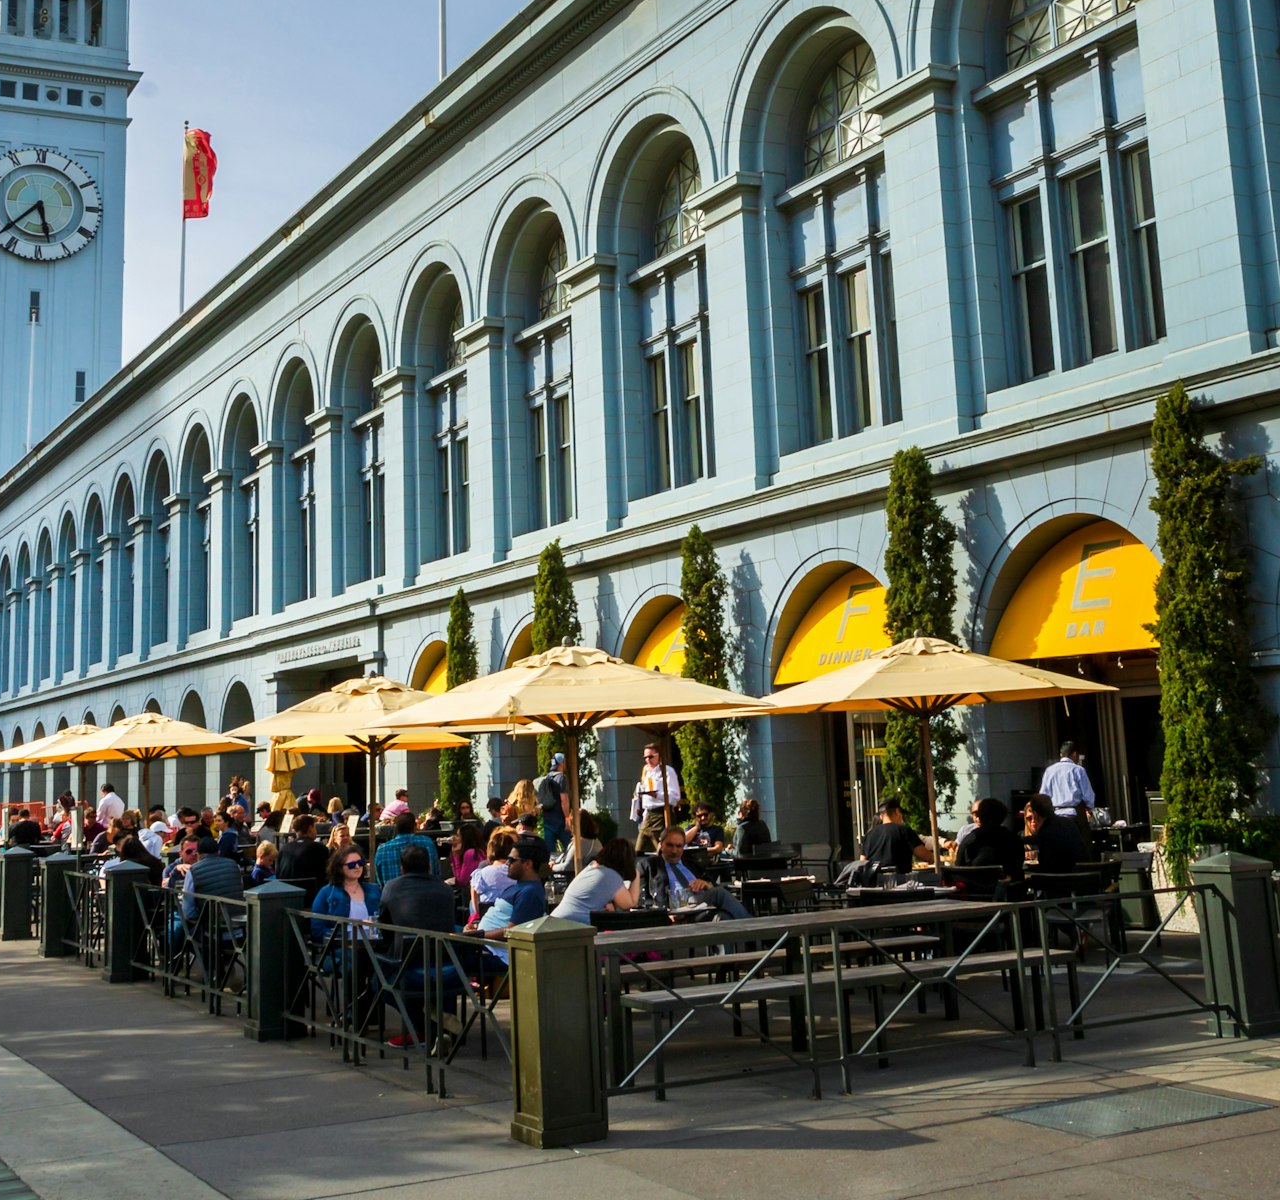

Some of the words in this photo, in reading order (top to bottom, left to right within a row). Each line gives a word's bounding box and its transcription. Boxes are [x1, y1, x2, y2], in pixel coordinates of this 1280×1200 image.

[1071, 539, 1123, 612] E
[836, 582, 877, 642] F
[1066, 620, 1106, 638] BAR
[818, 648, 872, 666] DINNER
